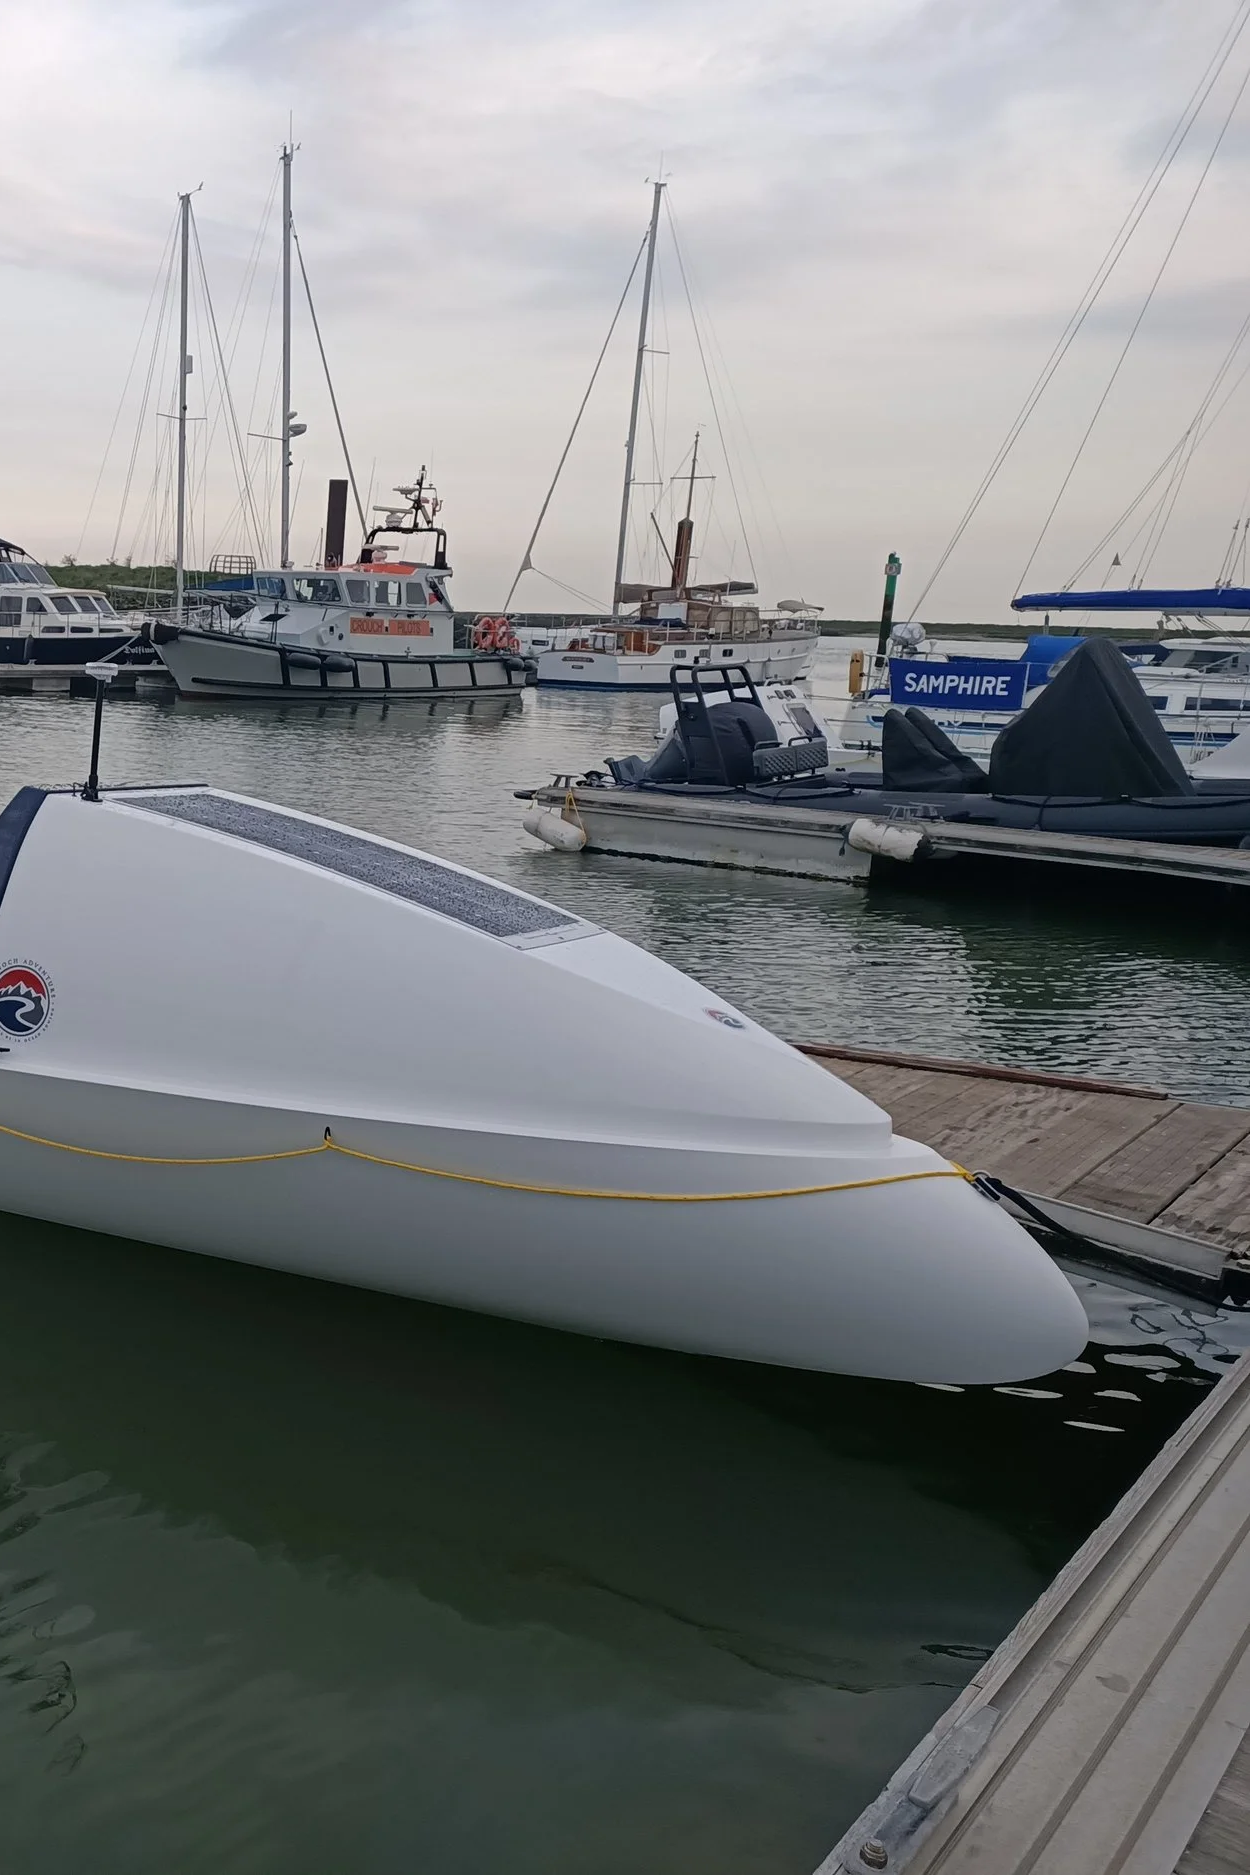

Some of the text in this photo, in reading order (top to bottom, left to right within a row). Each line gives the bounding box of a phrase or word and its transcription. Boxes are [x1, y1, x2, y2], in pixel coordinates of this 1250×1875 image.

[351, 619, 422, 634] CROUCH PILOTS
[904, 673, 1012, 696] SAMPHIRE
[23, 959, 56, 999] ADVENTURE
